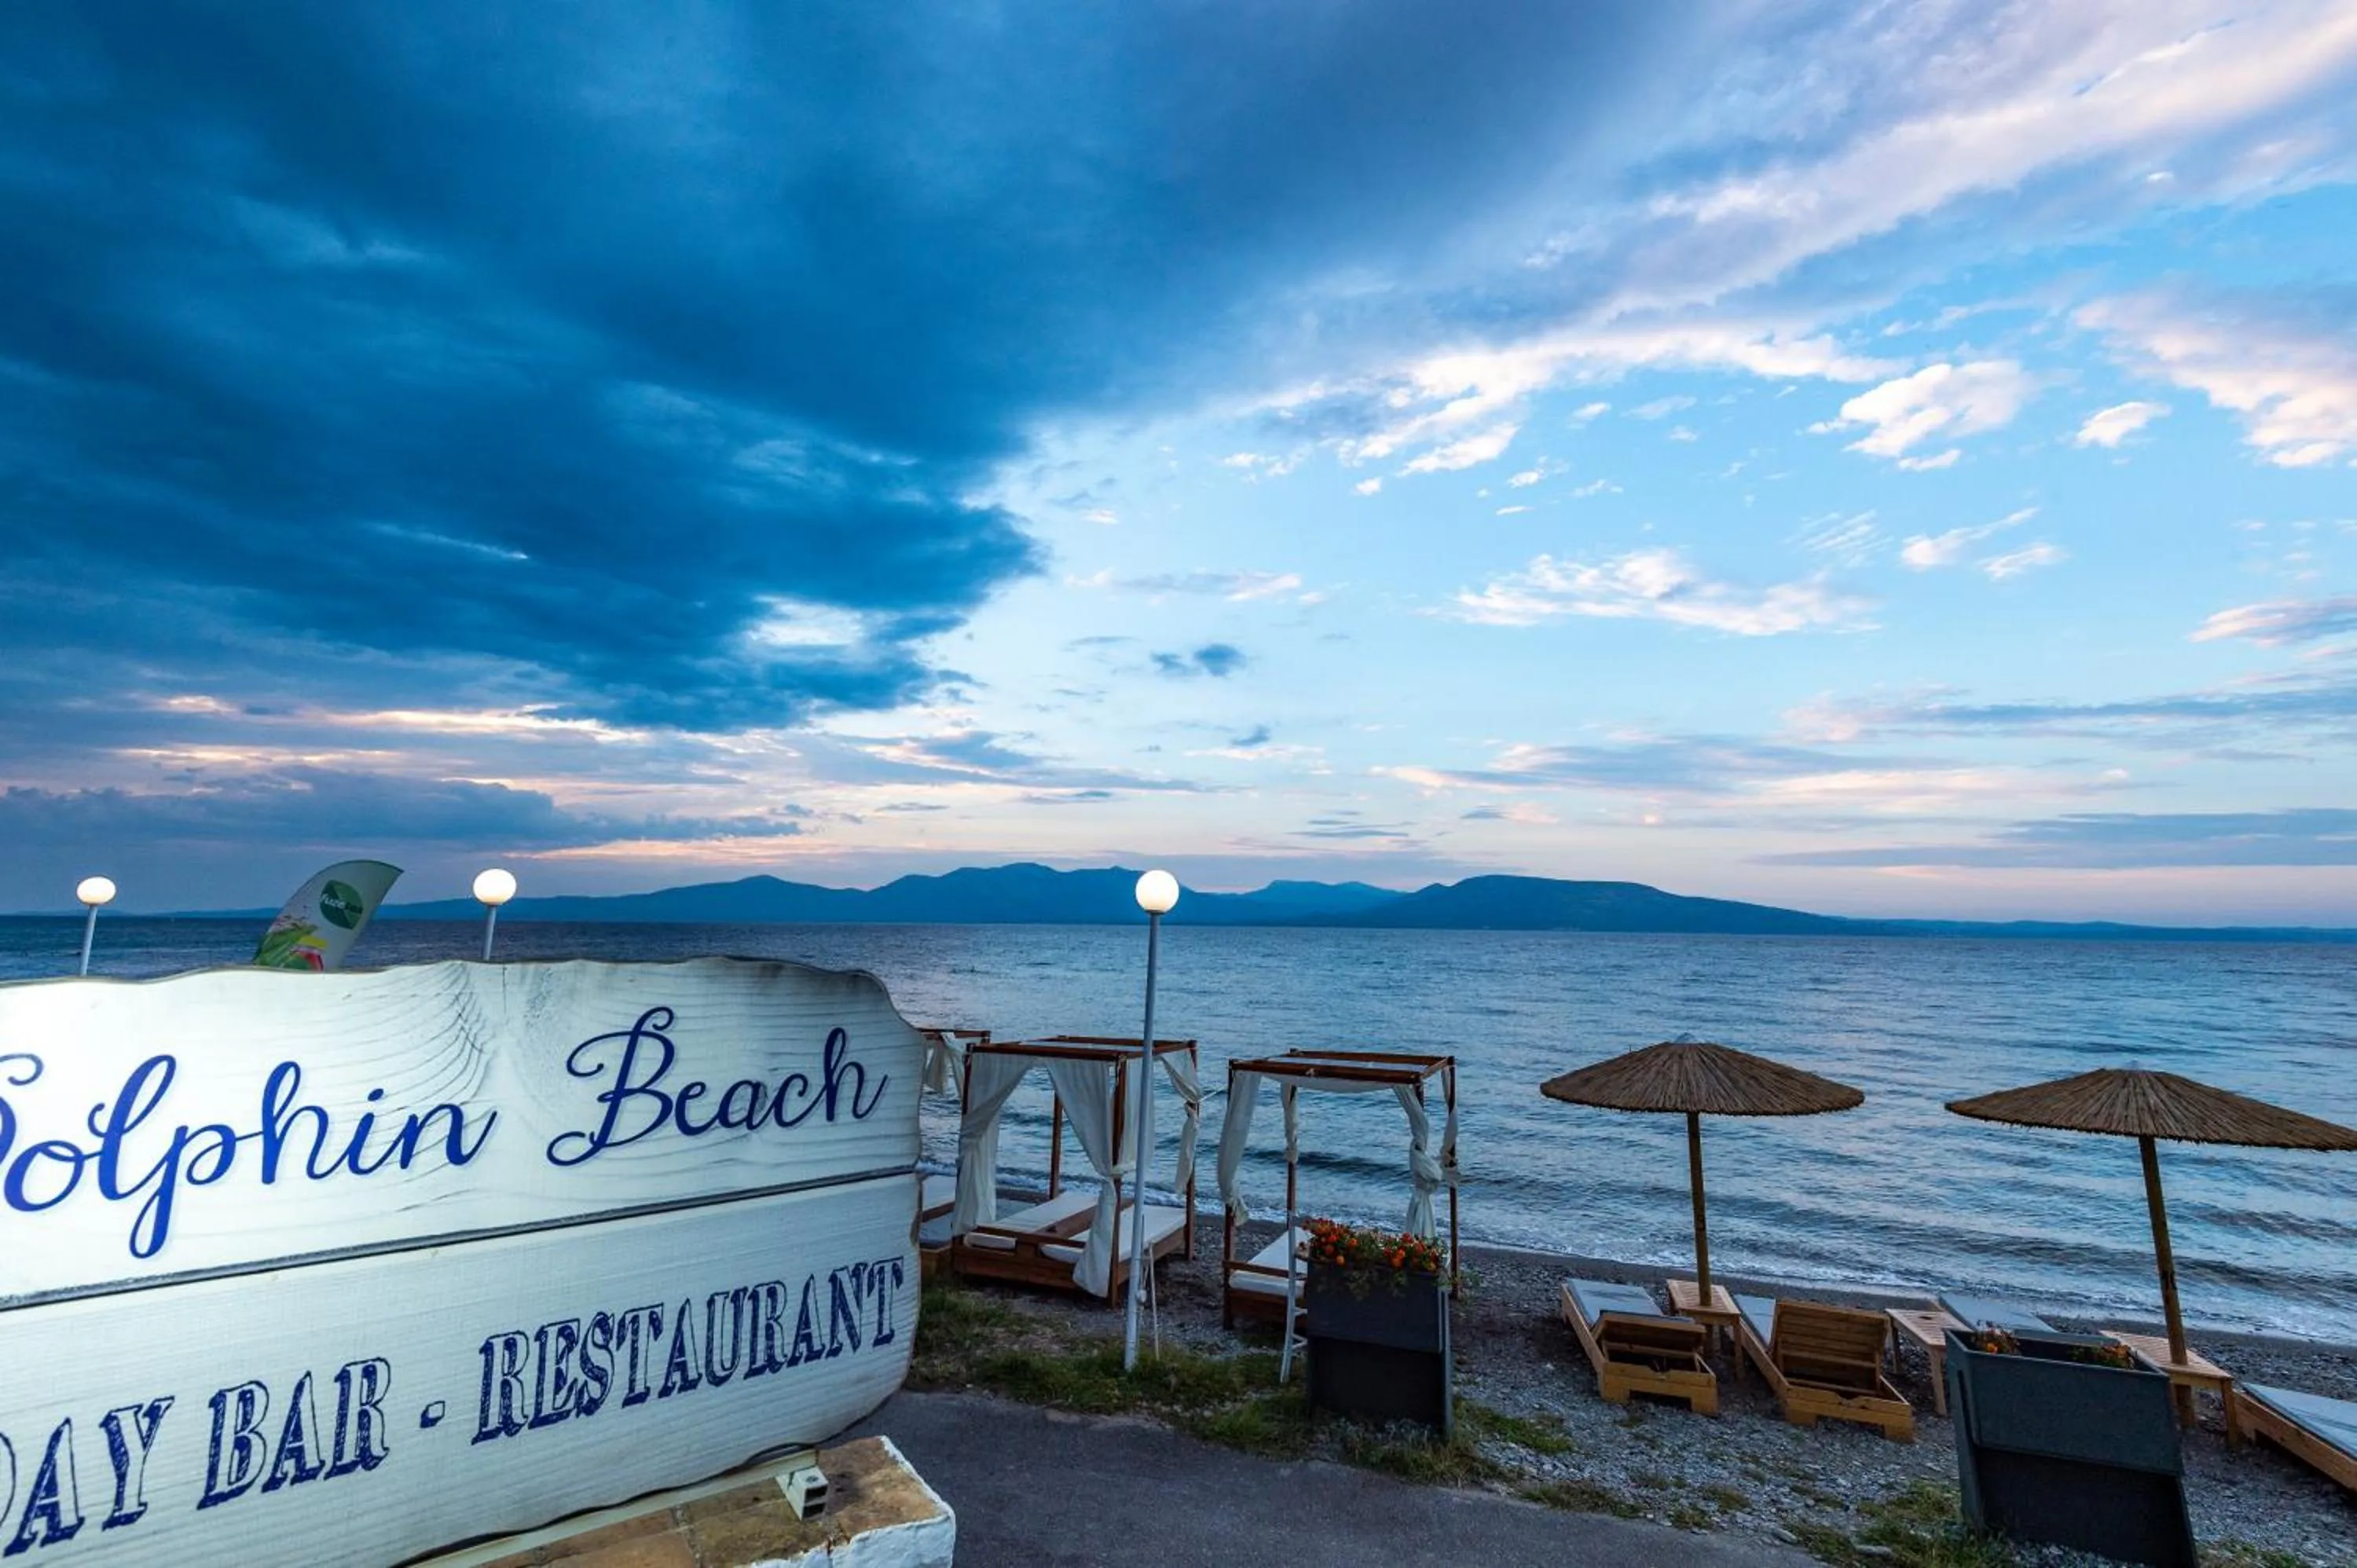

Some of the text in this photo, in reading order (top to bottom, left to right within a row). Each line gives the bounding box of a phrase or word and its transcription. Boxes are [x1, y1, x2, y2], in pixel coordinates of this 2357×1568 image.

[546, 1006, 889, 1167] Beach
[196, 1357, 391, 1511] BAR
[471, 1256, 904, 1446] RESTAURANT
